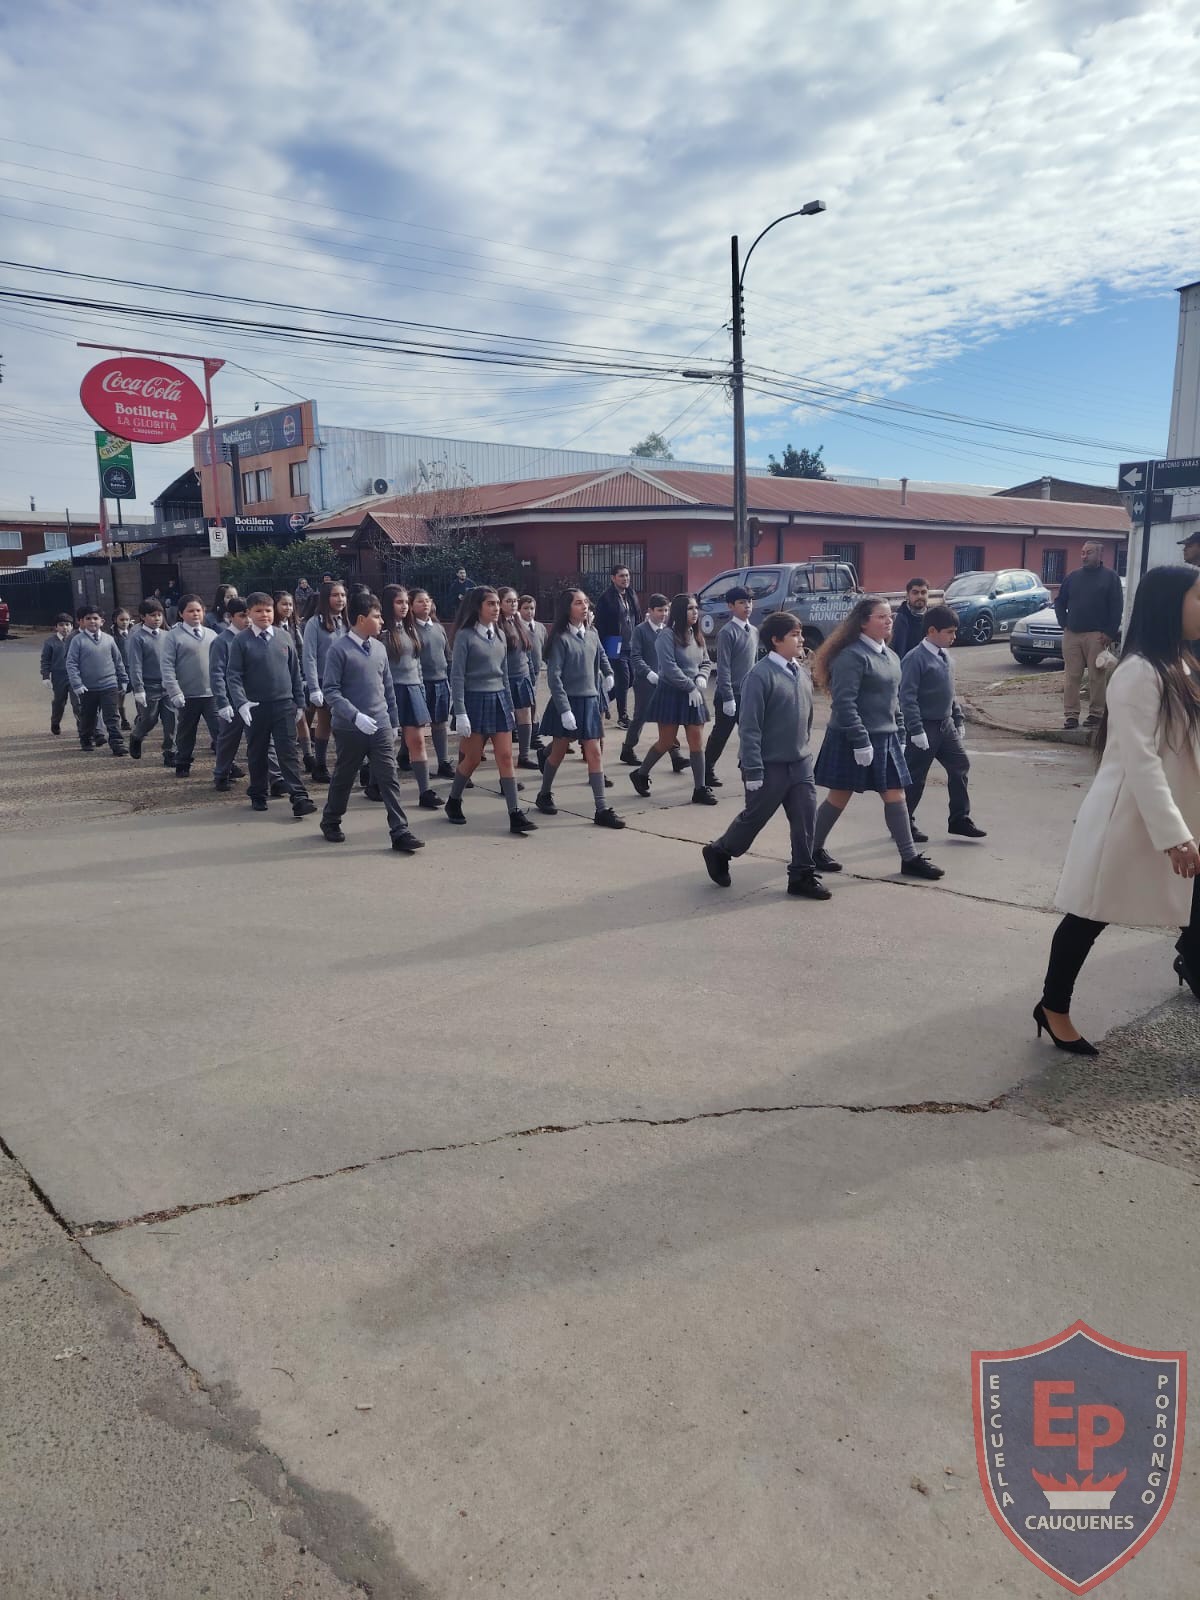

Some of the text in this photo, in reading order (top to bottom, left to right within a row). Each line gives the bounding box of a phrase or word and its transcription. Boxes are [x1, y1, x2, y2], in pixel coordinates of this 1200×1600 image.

[102, 371, 185, 401] Coca-Cola
[117, 416, 131, 425] LA
[215, 531, 222, 540] E
[810, 601, 857, 612] SEGURIDA
[809, 611, 849, 622] MUNICIP
